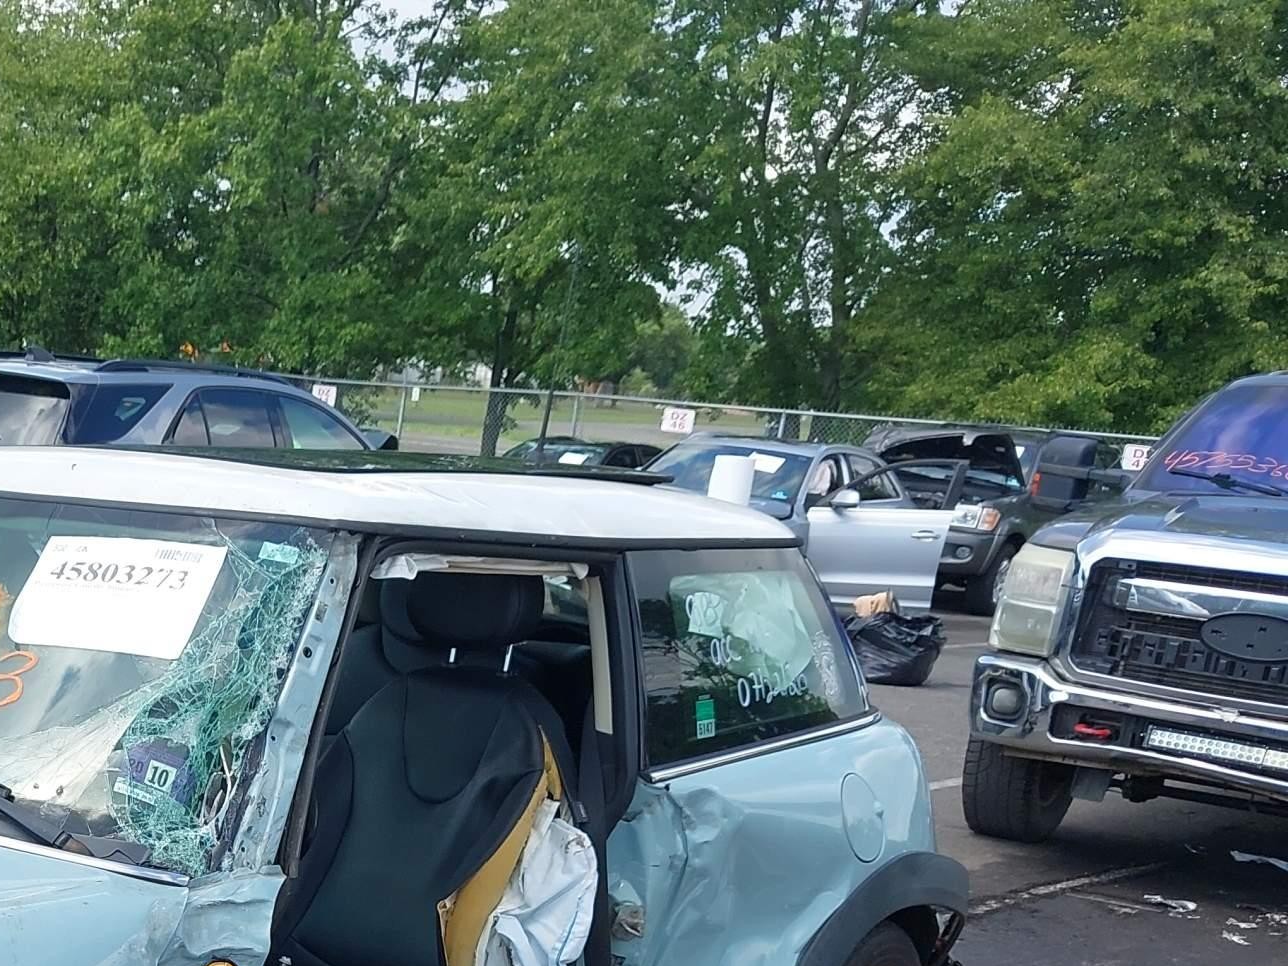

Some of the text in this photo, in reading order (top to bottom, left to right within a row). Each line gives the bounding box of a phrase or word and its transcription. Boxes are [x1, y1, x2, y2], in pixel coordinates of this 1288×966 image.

[672, 412, 688, 420] DZ
[50, 560, 190, 591] 45803273
[148, 765, 169, 788] 10
